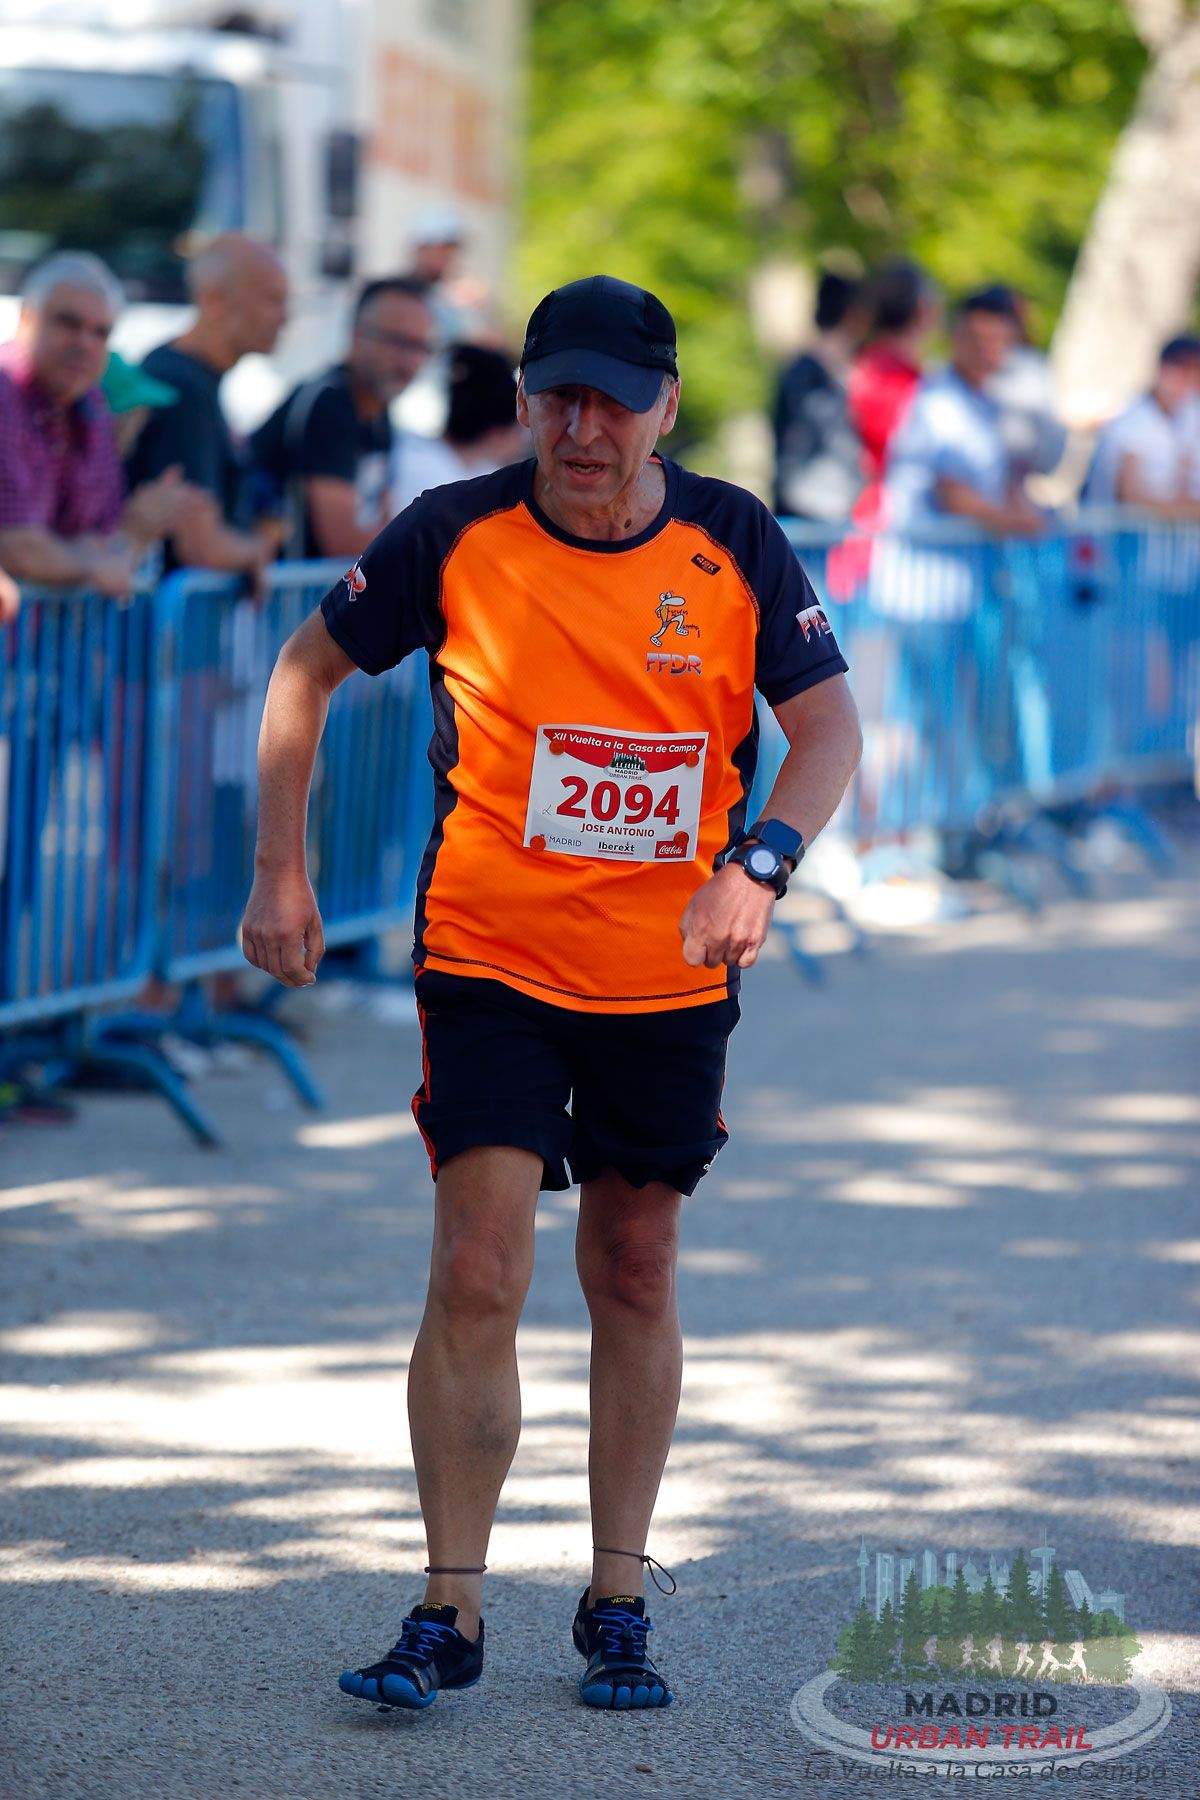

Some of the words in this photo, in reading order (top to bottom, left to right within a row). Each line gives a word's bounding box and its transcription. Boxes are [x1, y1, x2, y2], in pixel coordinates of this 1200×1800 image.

[646, 652, 703, 675] FFDR
[553, 732, 567, 742] XII
[569, 733, 602, 747] Vuelta
[613, 740, 624, 750] la
[628, 743, 653, 753] Casa
[655, 744, 667, 753] de
[668, 744, 697, 755] Campo
[556, 775, 680, 826] 2094
[549, 835, 582, 847] MADRID
[580, 823, 605, 834] JOSE
[606, 824, 655, 838] ANTONIO
